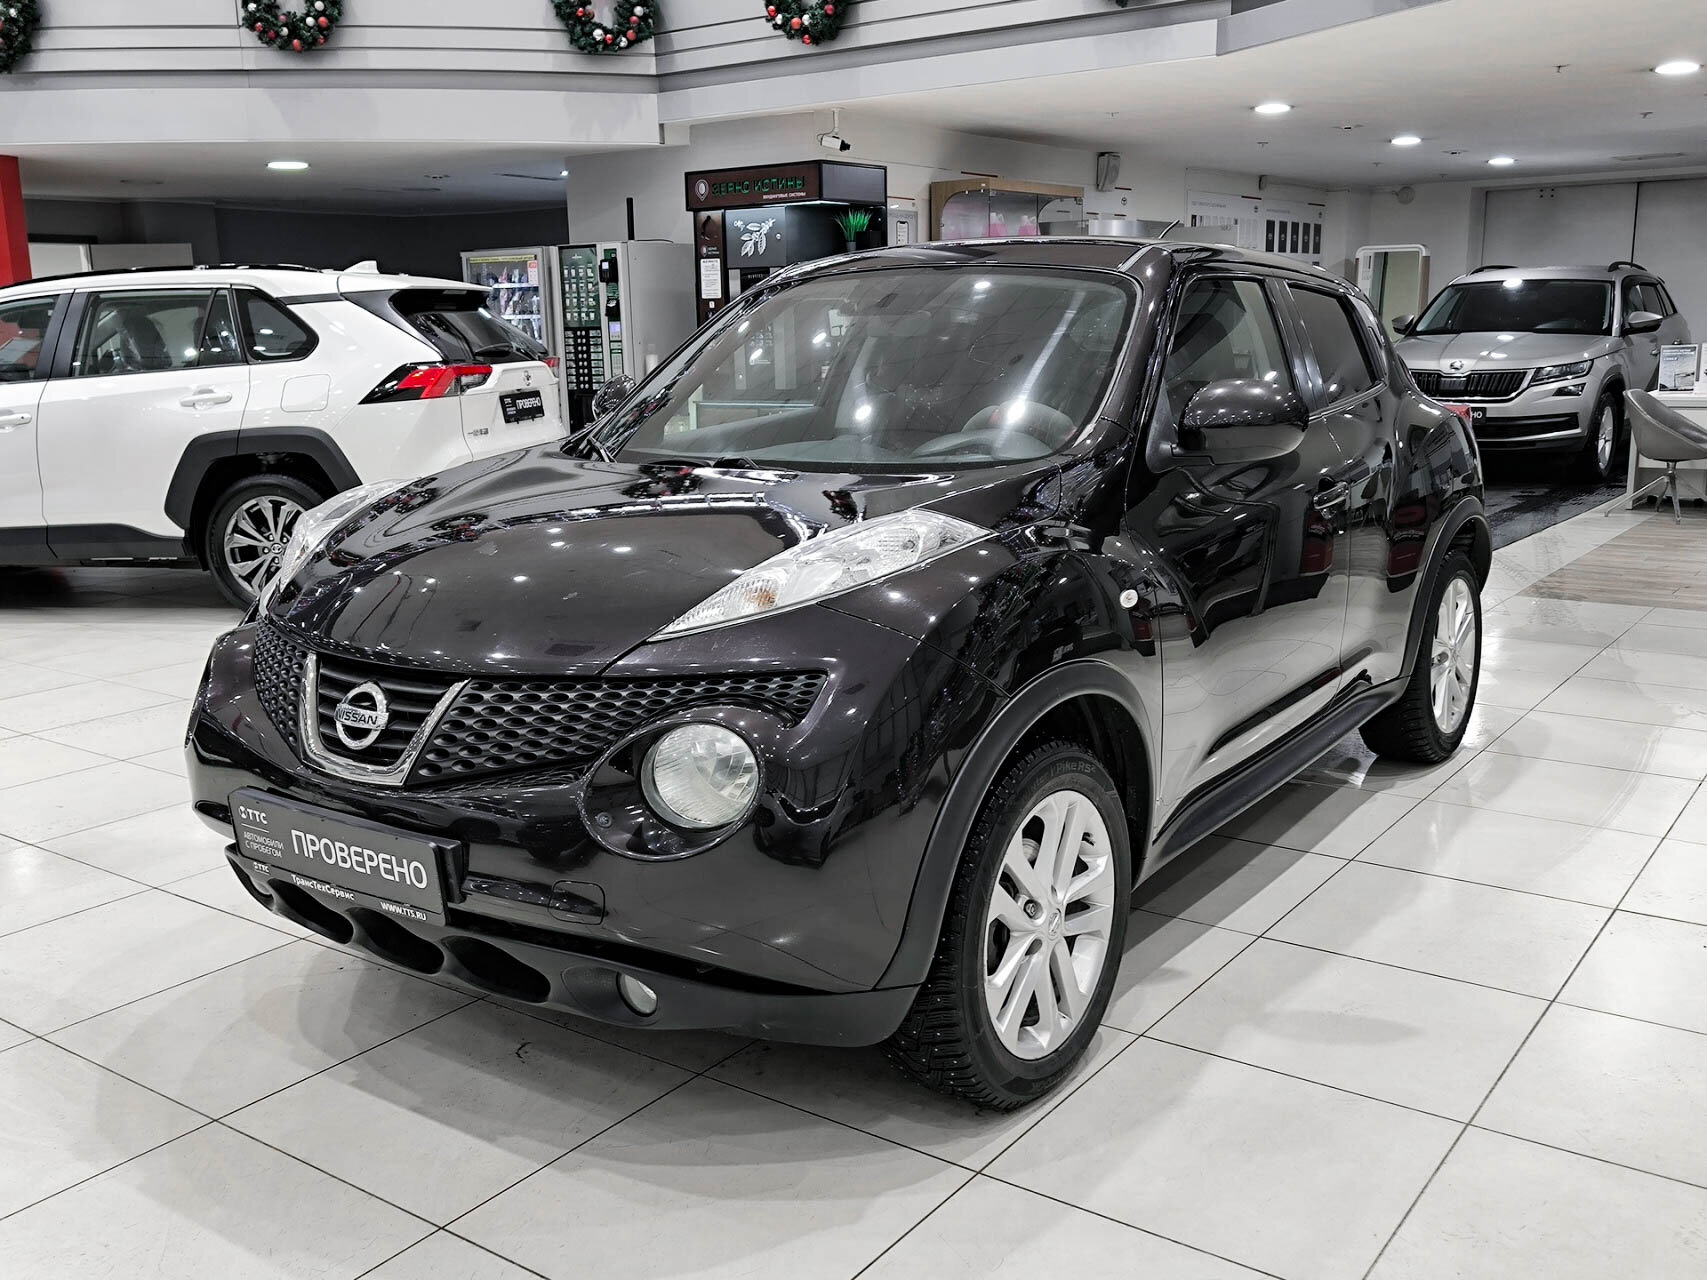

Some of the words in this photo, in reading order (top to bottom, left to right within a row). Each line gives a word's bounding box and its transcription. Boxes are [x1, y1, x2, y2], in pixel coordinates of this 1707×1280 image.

[711, 181, 750, 197] ЗЕРНО
[753, 176, 806, 193] ИСТИНЫ
[336, 708, 379, 725] NISSAN
[243, 831, 285, 850] АВТОМОБИЛИ
[250, 841, 283, 858] ПРОБЕГОМ
[291, 829, 429, 890] ПРОВЕРЕНО
[290, 874, 356, 901] ТрансТехСервис
